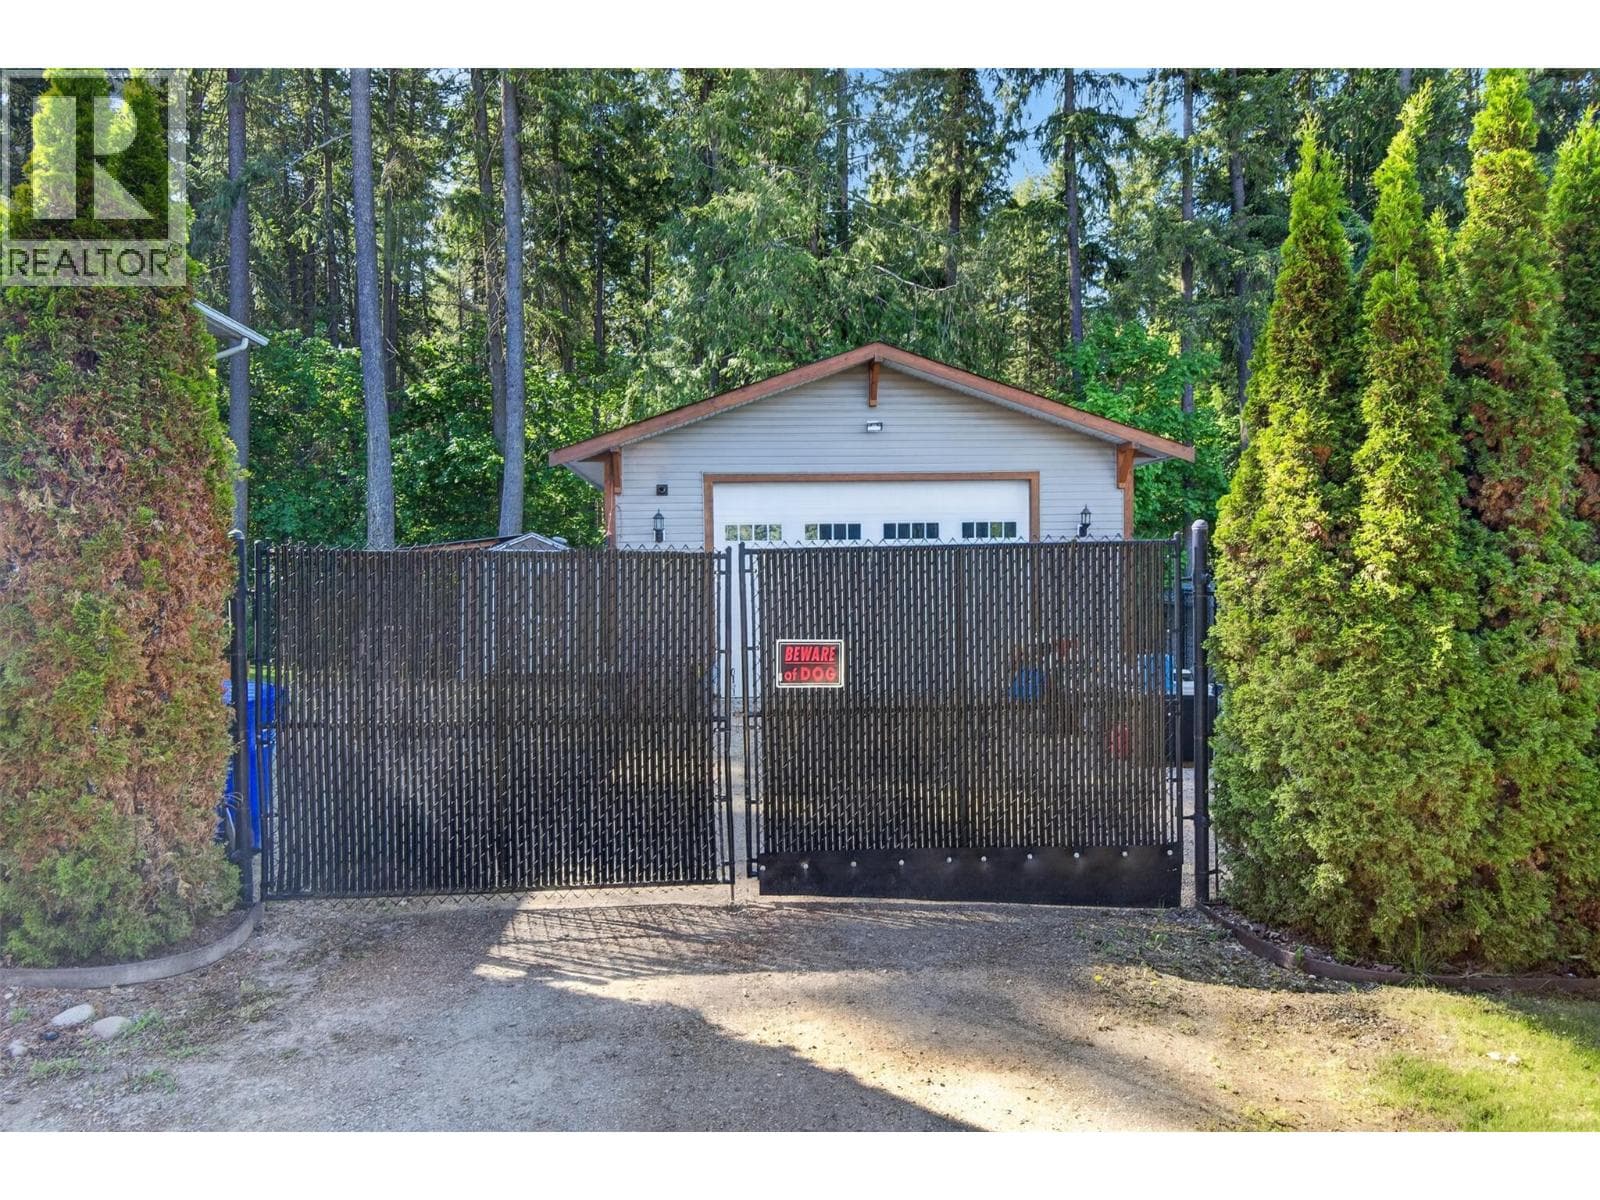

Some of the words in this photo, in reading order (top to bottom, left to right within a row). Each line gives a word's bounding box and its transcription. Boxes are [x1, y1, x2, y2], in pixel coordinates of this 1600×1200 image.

[784, 646, 836, 662] BEWARE
[784, 668, 798, 681] of
[800, 667, 836, 681] DOG
